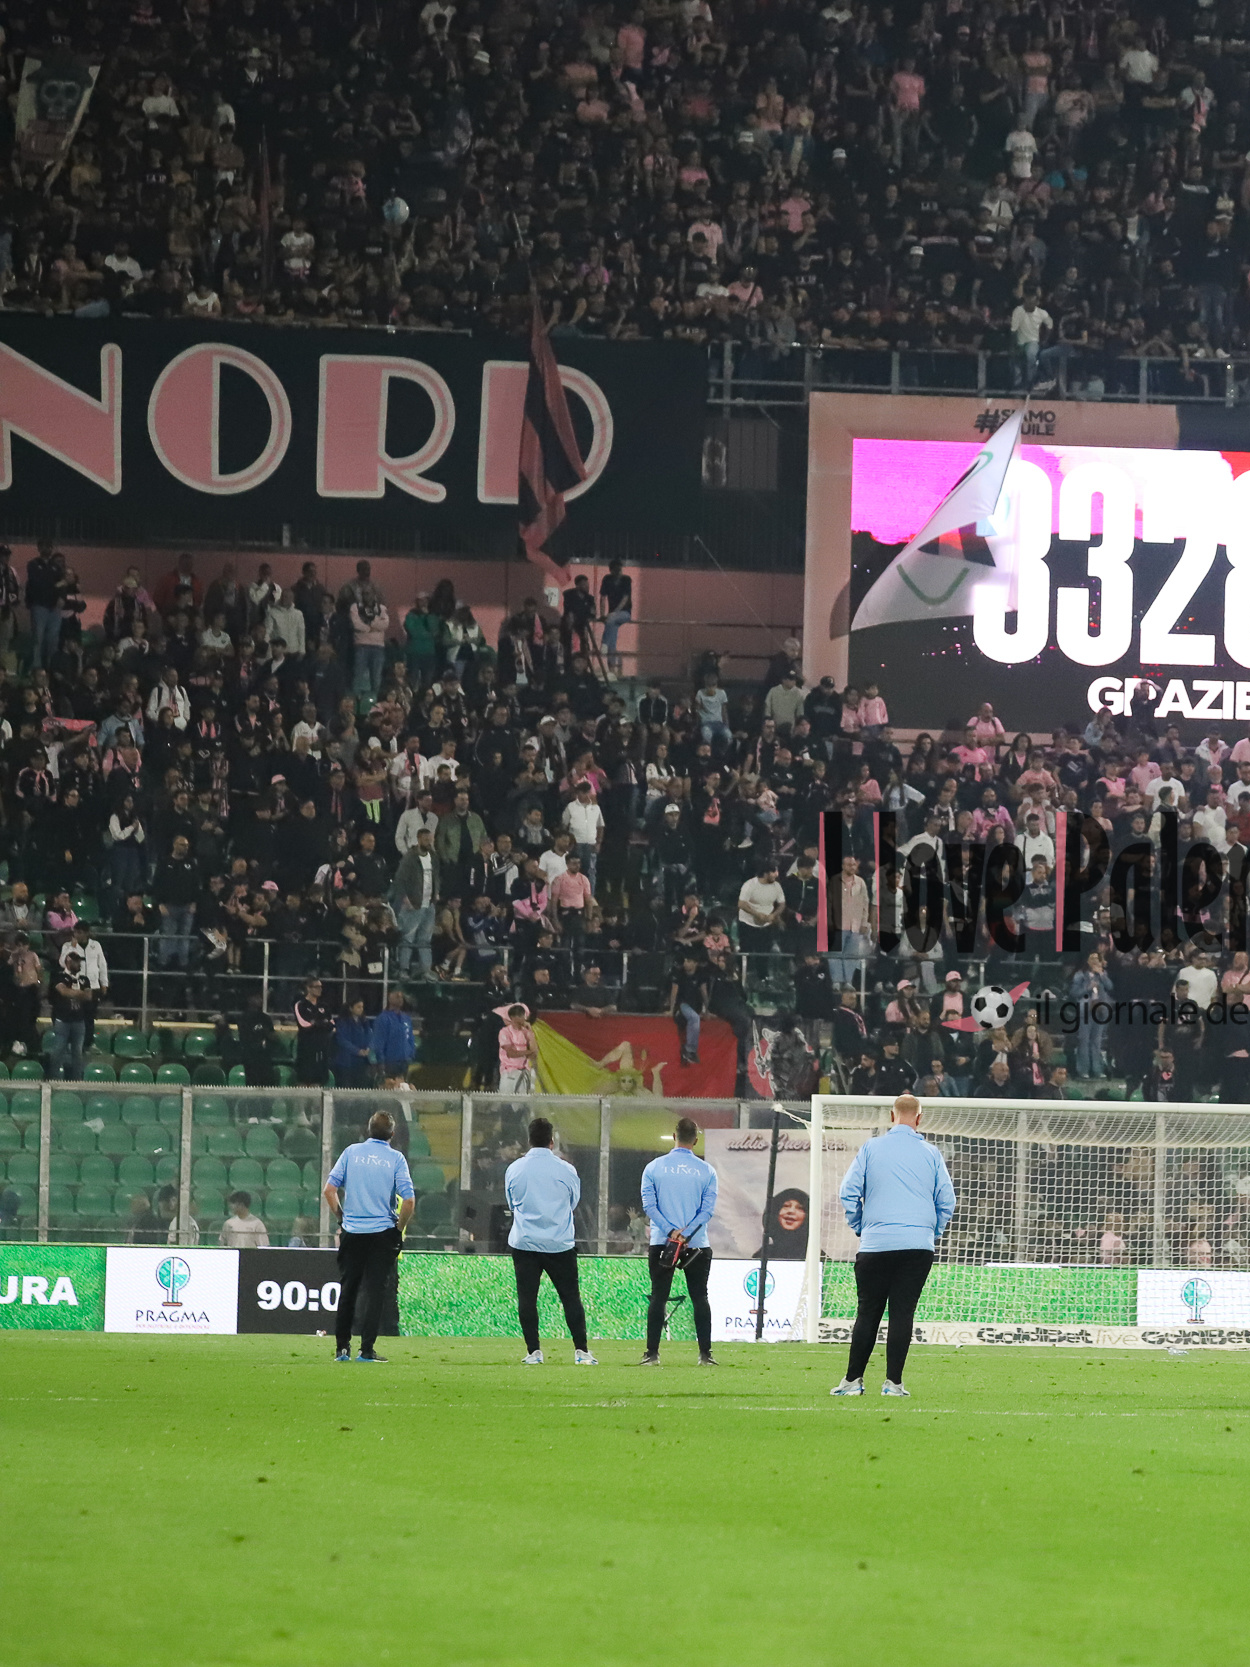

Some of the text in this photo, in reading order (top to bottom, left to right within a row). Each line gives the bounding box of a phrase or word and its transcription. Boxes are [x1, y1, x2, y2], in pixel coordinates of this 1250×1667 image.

[0, 342, 613, 503] NORD
[974, 408, 1056, 433] #SMO
[135, 1309, 211, 1323] PRAGMA
[725, 1316, 793, 1329] PRAMA
